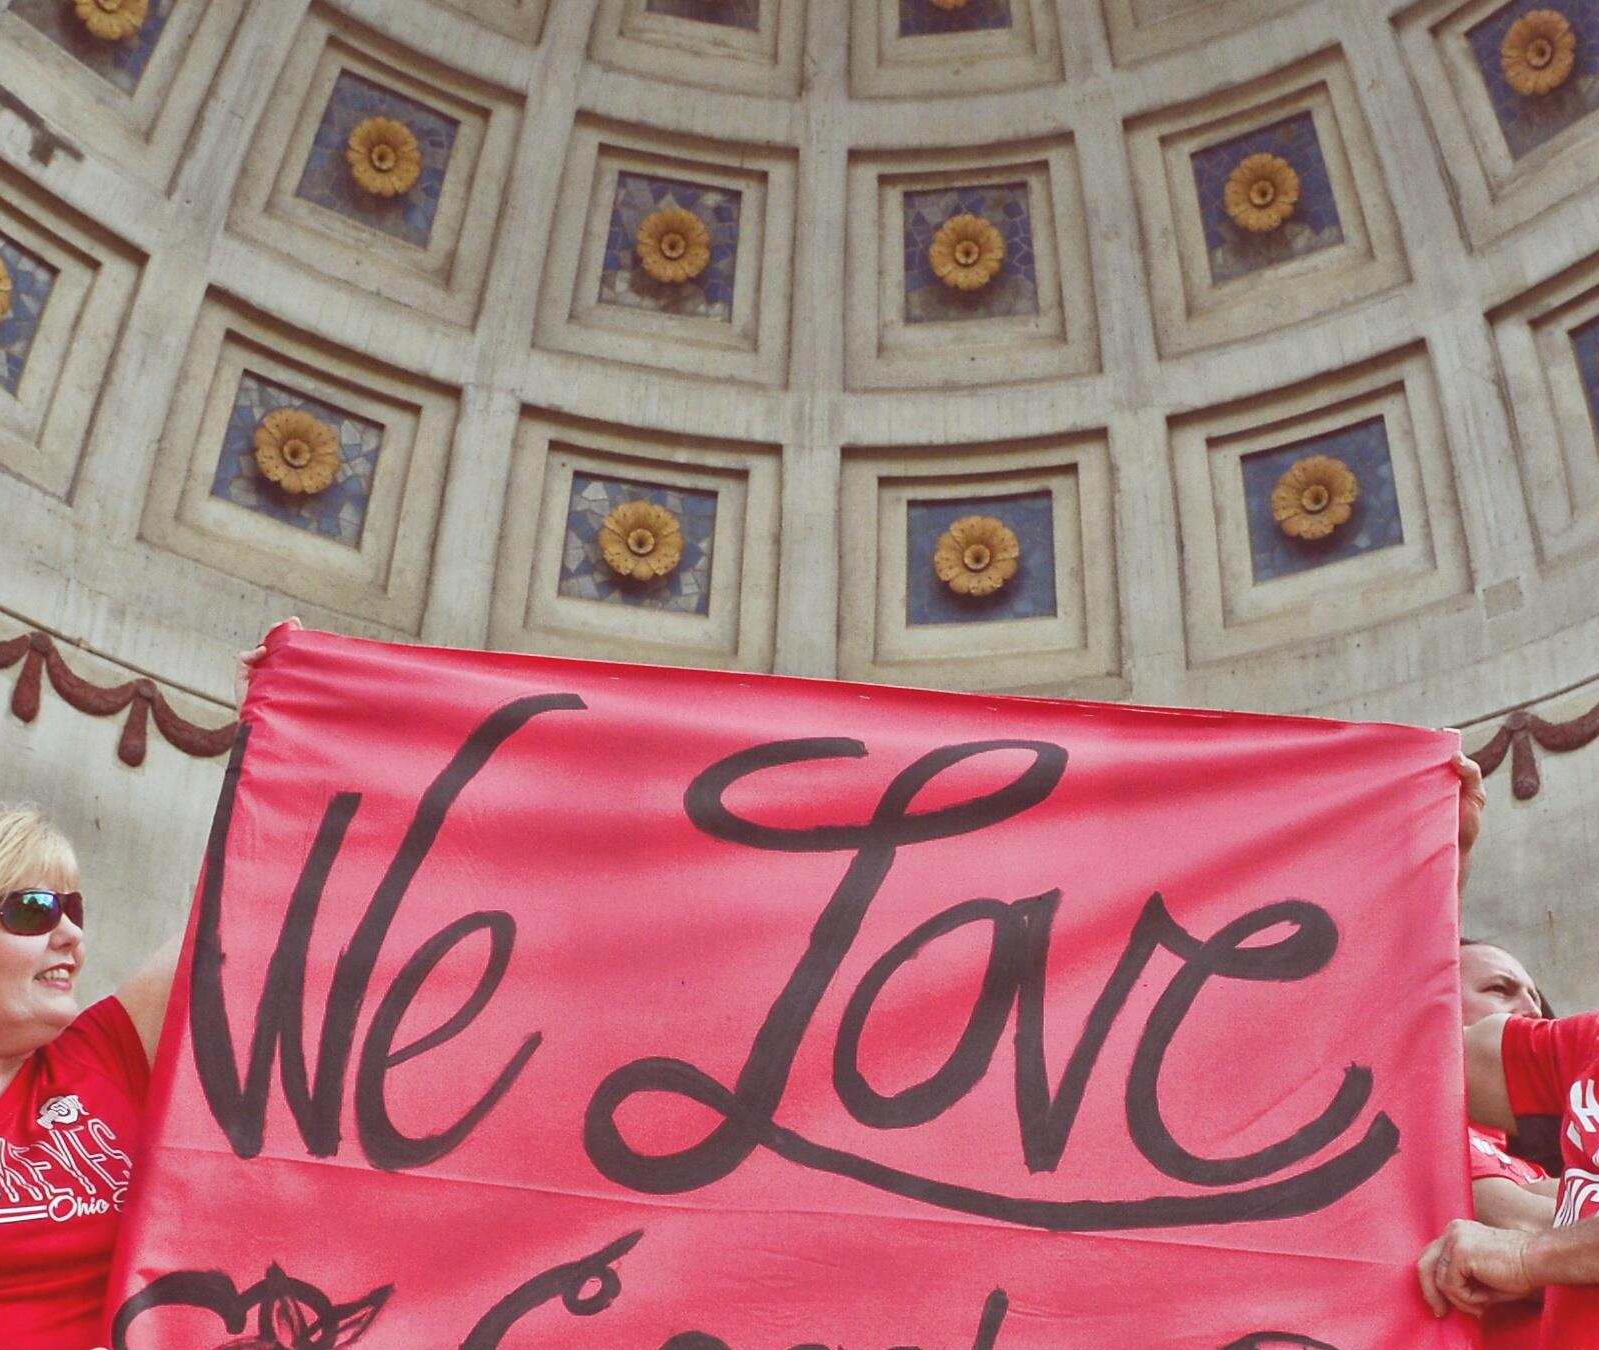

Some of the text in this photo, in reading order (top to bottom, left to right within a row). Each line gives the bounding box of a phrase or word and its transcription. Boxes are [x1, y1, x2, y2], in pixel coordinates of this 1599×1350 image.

[196, 693, 1400, 1231] We Love
[48, 1194, 110, 1222] Ohio
